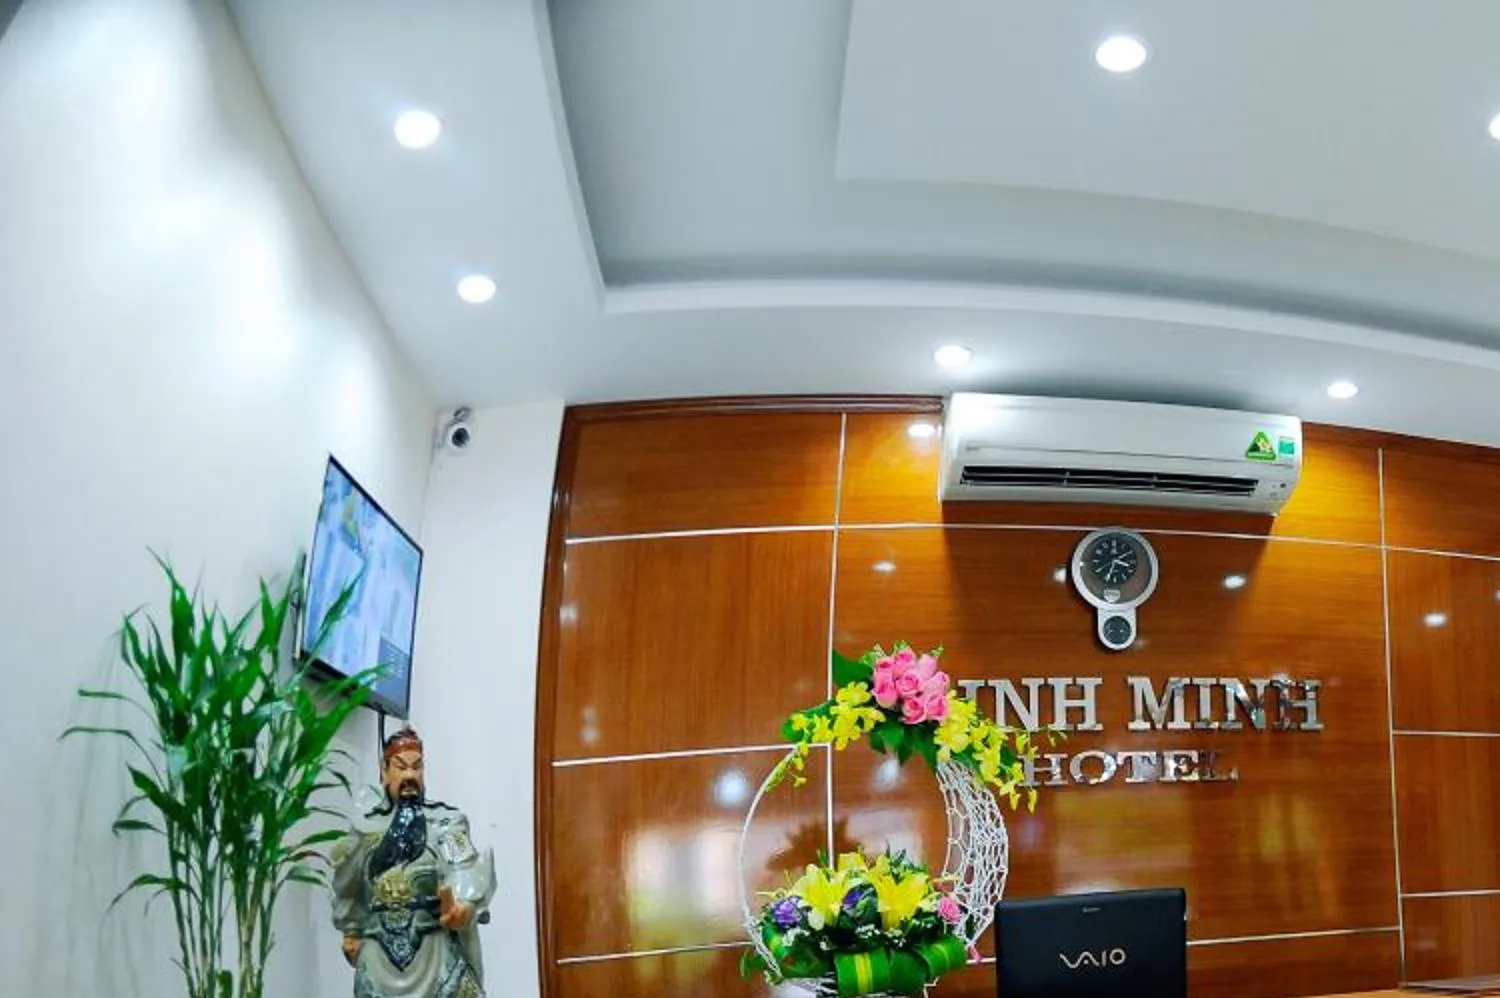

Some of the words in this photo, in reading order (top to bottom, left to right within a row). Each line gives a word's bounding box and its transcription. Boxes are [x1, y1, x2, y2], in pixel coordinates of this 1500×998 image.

[1127, 674, 1325, 732] MINH
[1017, 750, 1239, 787] HOTEL
[1059, 948, 1126, 968] VAIO
